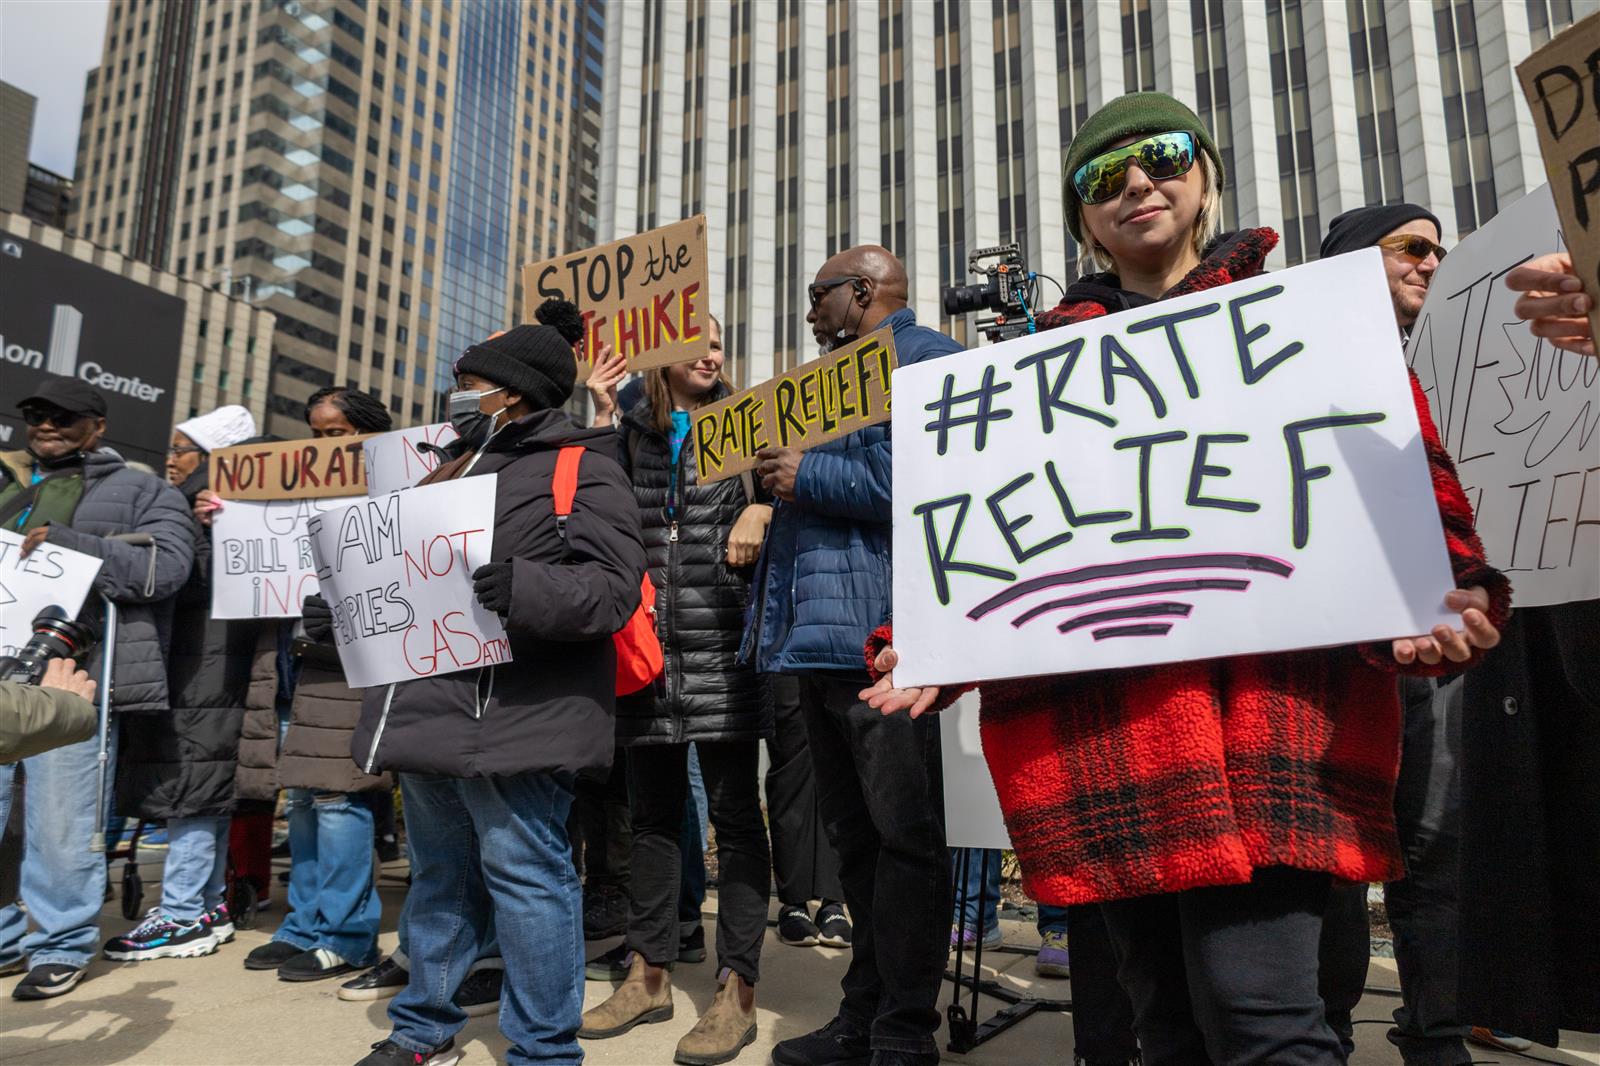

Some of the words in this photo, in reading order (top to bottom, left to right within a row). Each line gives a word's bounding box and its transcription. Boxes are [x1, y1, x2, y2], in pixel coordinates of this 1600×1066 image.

[537, 244, 635, 304] STOP
[640, 237, 692, 287] the
[614, 281, 702, 359] HIKE
[0, 333, 44, 369] on
[79, 361, 165, 402] Center
[925, 285, 1304, 456] #RATE
[693, 391, 769, 481] RATE
[775, 337, 893, 449] RELIEF!
[215, 451, 272, 493] NOT
[336, 494, 402, 573] AM
[404, 528, 486, 588] NOT
[913, 412, 1387, 606] RELIEF
[222, 537, 288, 575] BILL
[402, 611, 482, 676] GAS
[482, 638, 512, 665] ATM
